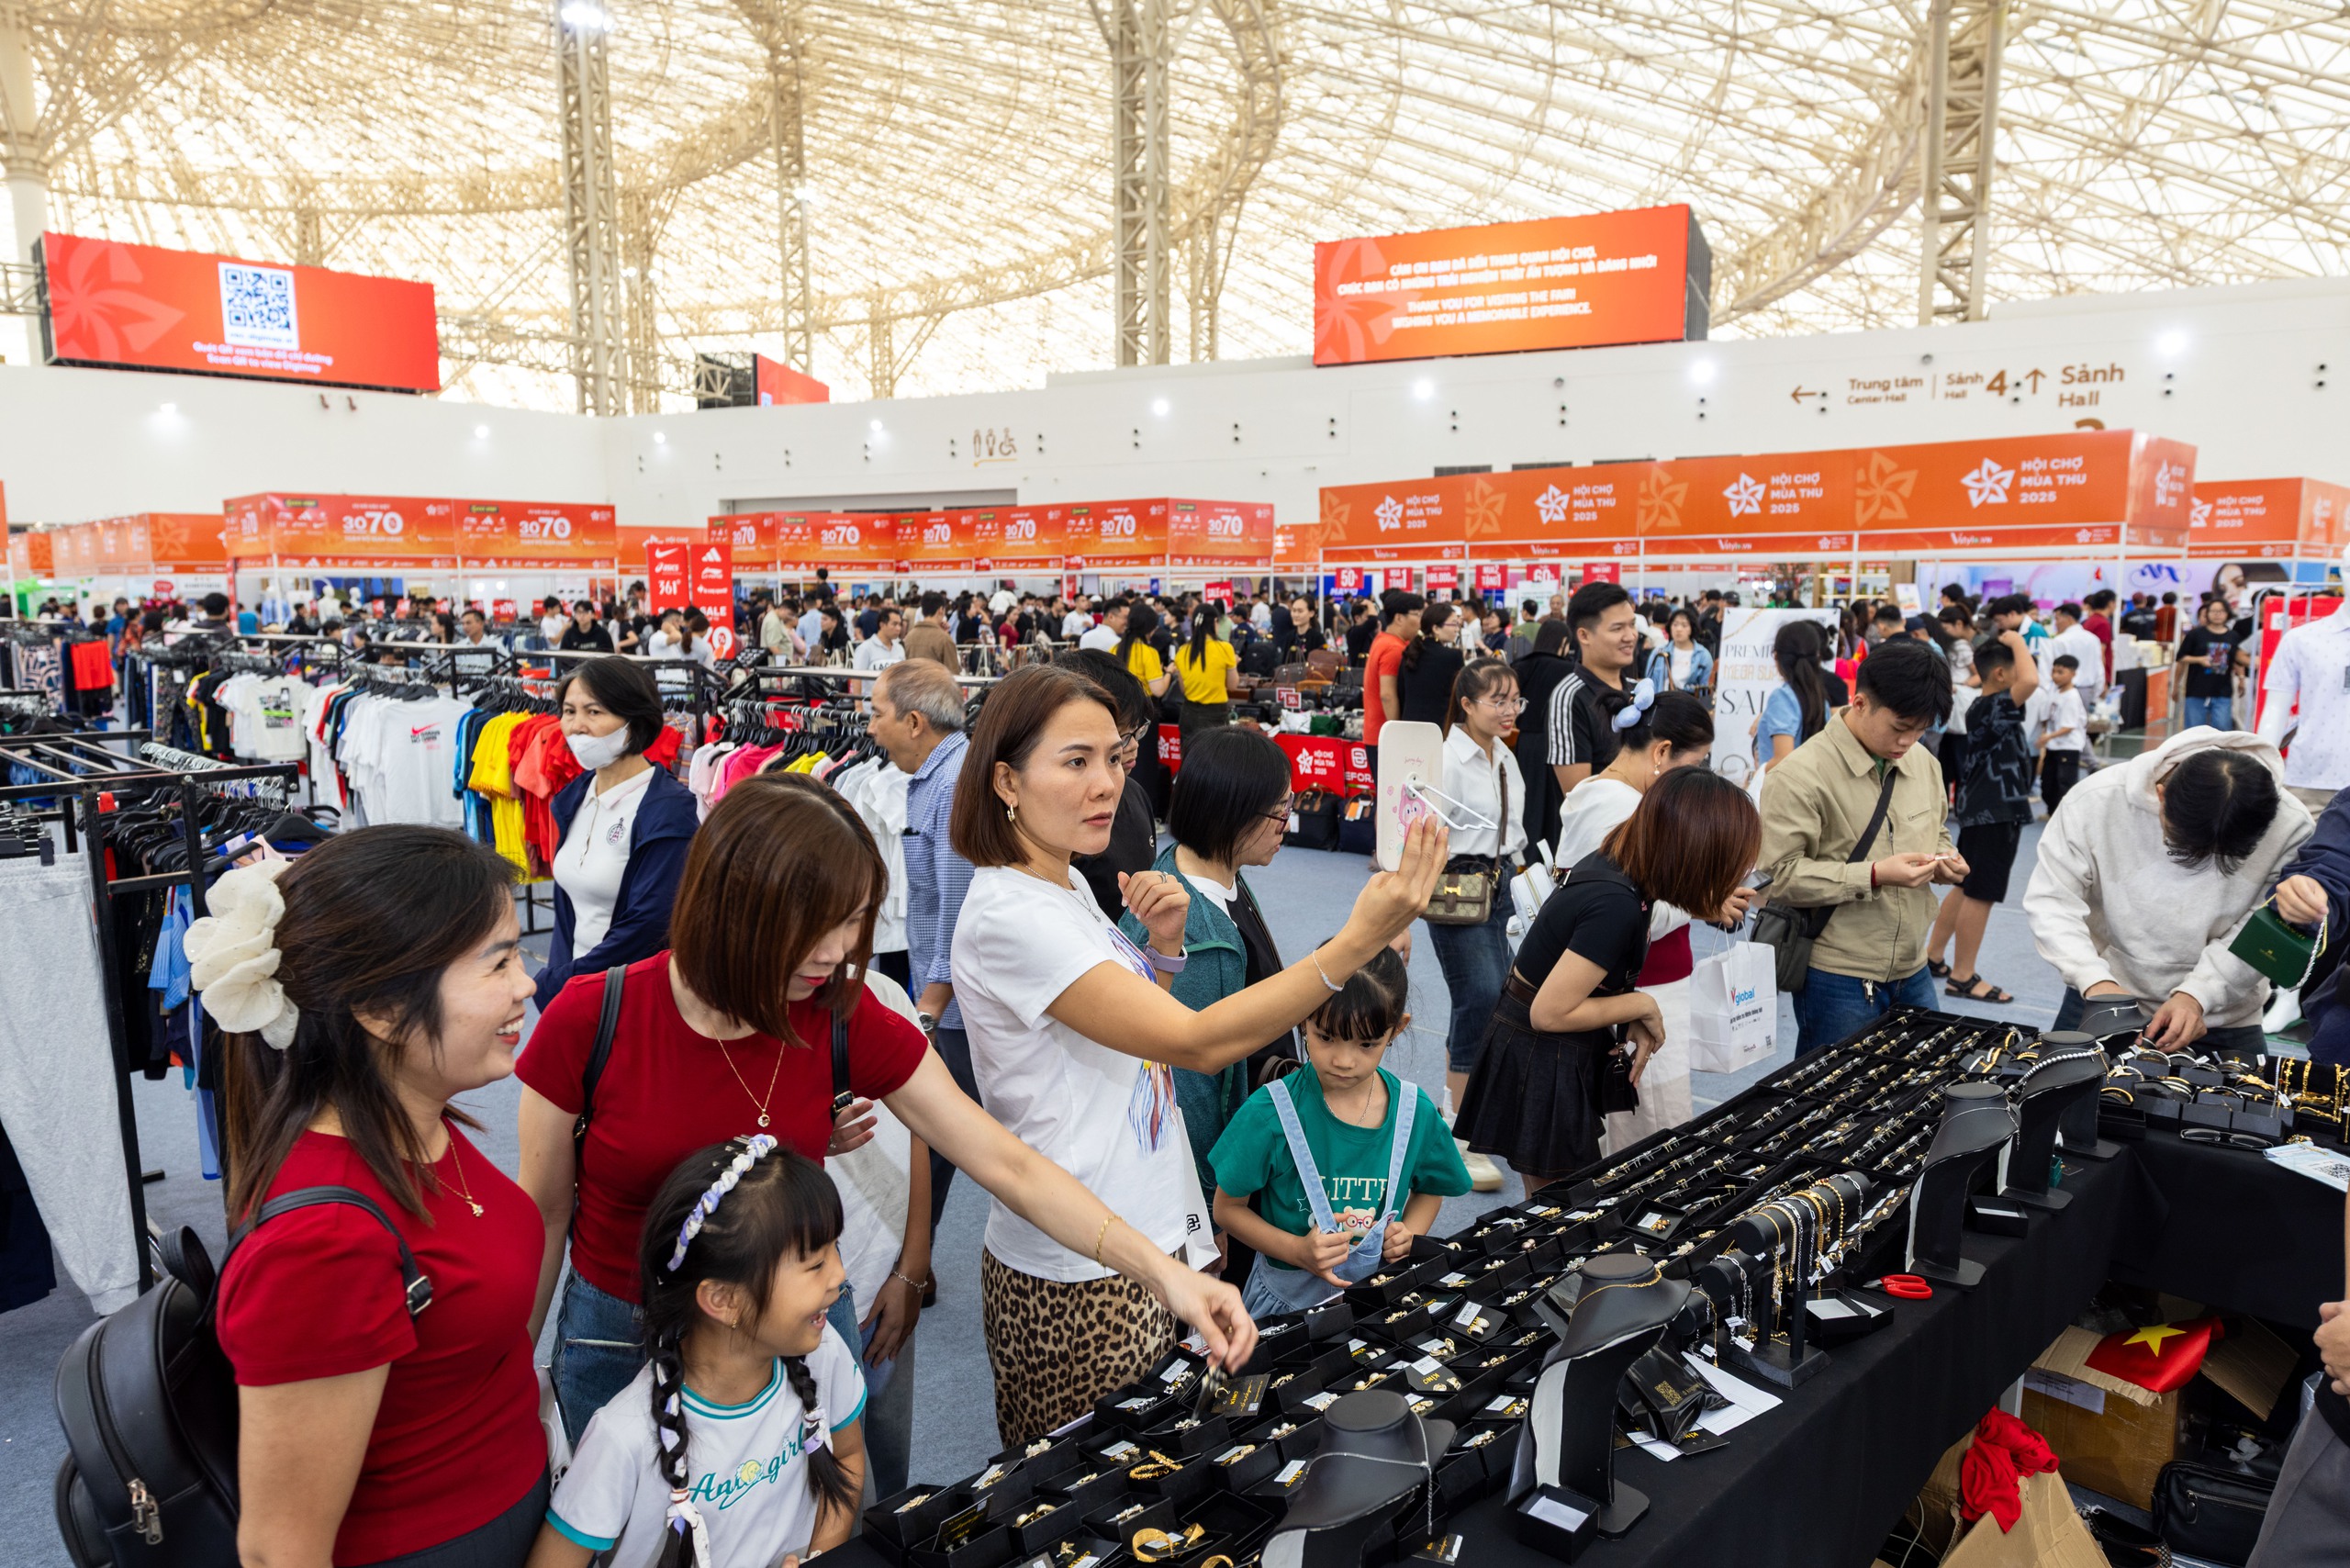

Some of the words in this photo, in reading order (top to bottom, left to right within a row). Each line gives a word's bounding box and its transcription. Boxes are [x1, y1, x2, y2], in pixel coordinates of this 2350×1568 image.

[1407, 300, 1440, 313] THANK
[1440, 297, 1463, 311] YOU
[1463, 296, 1485, 308] FOR
[1528, 290, 1549, 303] THE
[1434, 313, 1457, 326] YOU
[1457, 312, 1467, 324] A
[2061, 363, 2124, 385] Sảnh
[1849, 378, 1891, 392] Trung
[1946, 372, 1984, 386] Sảnh
[1986, 369, 2009, 397] 4
[1847, 395, 1882, 405] Center
[1885, 393, 1907, 403] Hall
[1944, 389, 1968, 399] Hall
[2058, 390, 2100, 408] Hall
[2020, 457, 2048, 471] HỘI
[2049, 455, 2084, 471] CHỢ
[1771, 473, 1792, 486] HỘI
[1794, 471, 1820, 485] CHỢ
[2020, 474, 2053, 487] MÙA
[2056, 473, 2087, 485] THU
[1770, 487, 1796, 499] MÙA
[1798, 487, 1823, 498] THU
[2020, 490, 2057, 503] 2025
[1595, 497, 1617, 508] THU
[1770, 503, 1800, 514] 2025
[1425, 507, 1442, 516] THU
[1572, 511, 1598, 521] 2025
[2244, 506, 2266, 516] THU
[1406, 519, 1427, 529] 2025
[2215, 519, 2244, 528] 2025
[1326, 758, 1336, 767] THU
